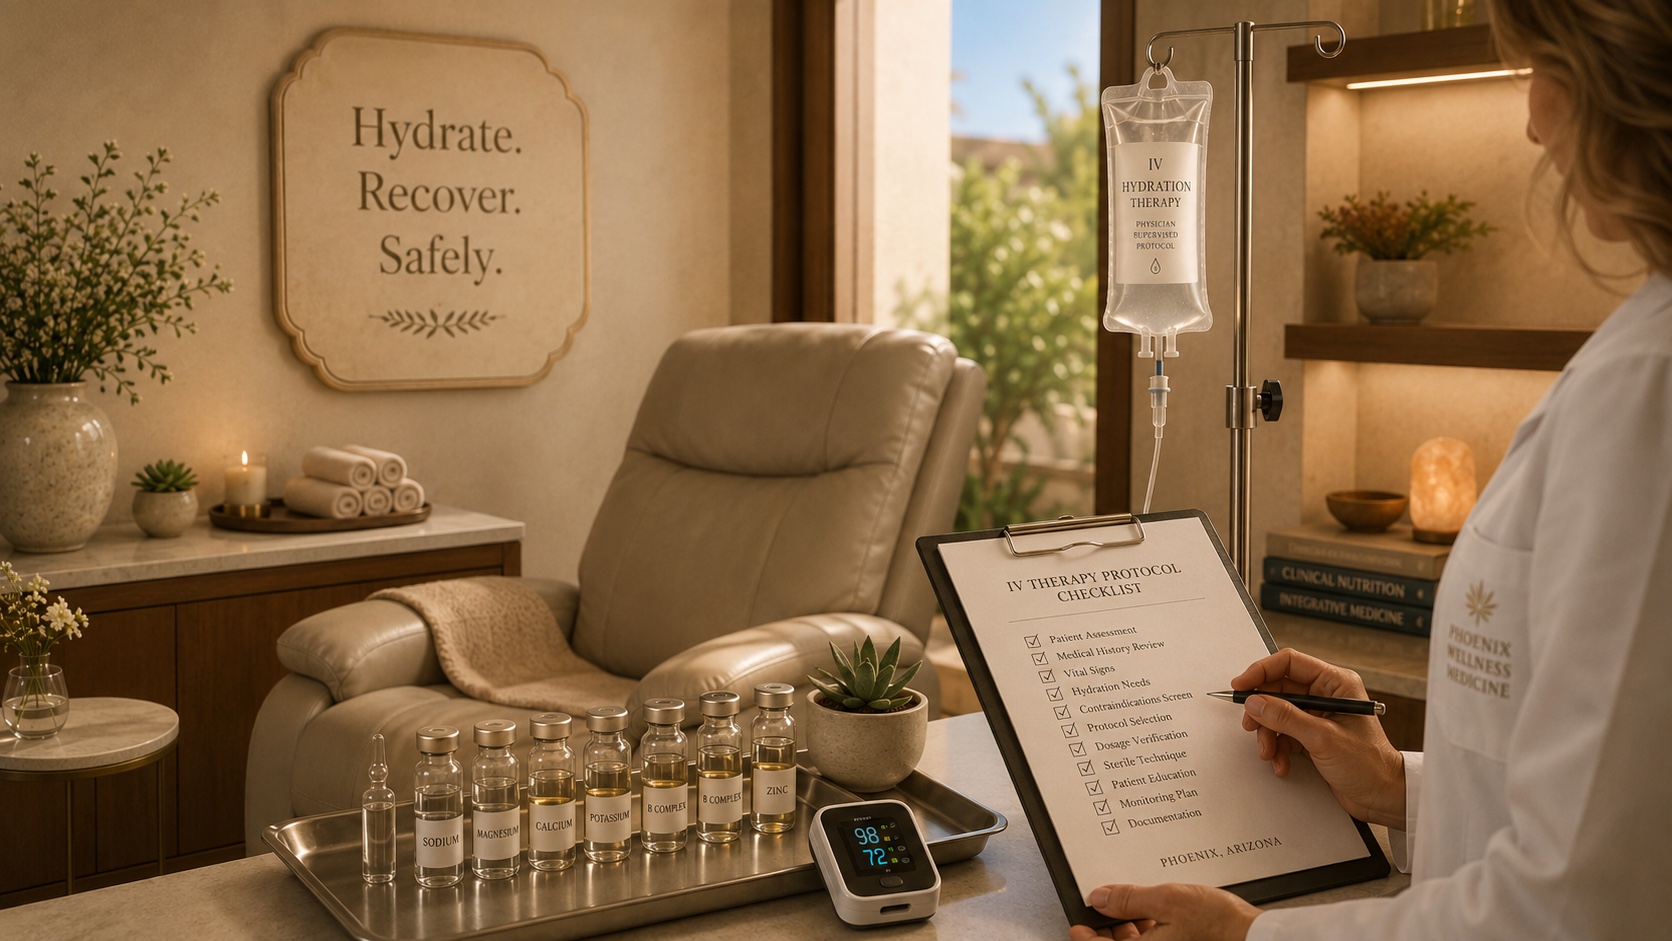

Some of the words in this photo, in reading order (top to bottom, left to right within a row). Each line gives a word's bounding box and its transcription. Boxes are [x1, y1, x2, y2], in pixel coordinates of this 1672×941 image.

[352, 106, 522, 160] Hydrate.
[1148, 158, 1163, 170] IV
[357, 170, 521, 215] Recover.
[1122, 181, 1192, 192] HYDRATION
[1130, 197, 1181, 208] THERAPY
[380, 234, 502, 286] Safely.
[1006, 580, 1023, 592] IV
[1027, 572, 1097, 590] THERAPY
[1101, 563, 1182, 582] PROTOCOL
[1281, 566, 1335, 588] CLINICAL
[1337, 574, 1405, 598] NUTRITION
[1057, 582, 1142, 602] CHECKLIST
[1279, 593, 1347, 616] INTEGRATIVE
[1350, 604, 1404, 626] MEDICINE
[1049, 632, 1083, 644] Patient
[1085, 626, 1138, 640] Assessment
[1448, 623, 1512, 658] PHOENIX
[1056, 648, 1095, 661] Medical
[1097, 644, 1131, 656] History
[1132, 640, 1165, 652] Review
[1447, 642, 1512, 678] WELLNESS
[1063, 667, 1088, 678] Vital
[1090, 664, 1116, 676] Signs
[1446, 663, 1511, 699] MEDICINE
[1071, 683, 1120, 697] Hydration
[1122, 678, 1151, 690] Needs
[1079, 696, 1161, 714] Contraindications
[1162, 691, 1193, 702] Screen
[1087, 719, 1129, 732] Protocol
[1129, 712, 1173, 726] Selection
[1095, 738, 1131, 752] Dosage
[1132, 730, 1188, 744] Verification
[1103, 758, 1136, 770] Sterile
[1136, 750, 1188, 766] Technique
[1111, 776, 1147, 790] Patient
[1149, 768, 1197, 784] Education
[703, 795, 708, 803] B
[709, 792, 742, 804] COMPLEX
[766, 785, 788, 795] ZINC
[1120, 792, 1175, 809] Monitoring
[1176, 787, 1198, 800] Plan
[590, 810, 630, 823] POTASSIUM
[647, 804, 652, 813] B
[654, 801, 687, 813] COMPLEX
[536, 818, 573, 831] CALCIUM
[1127, 808, 1202, 829] Documentation
[422, 834, 460, 847] SODIUM
[477, 825, 519, 839] MAGNESIUM
[854, 826, 880, 845] 98
[863, 848, 888, 866] 72
[1160, 848, 1224, 868] PHOENIX,
[1226, 836, 1282, 856] ARIZONA
